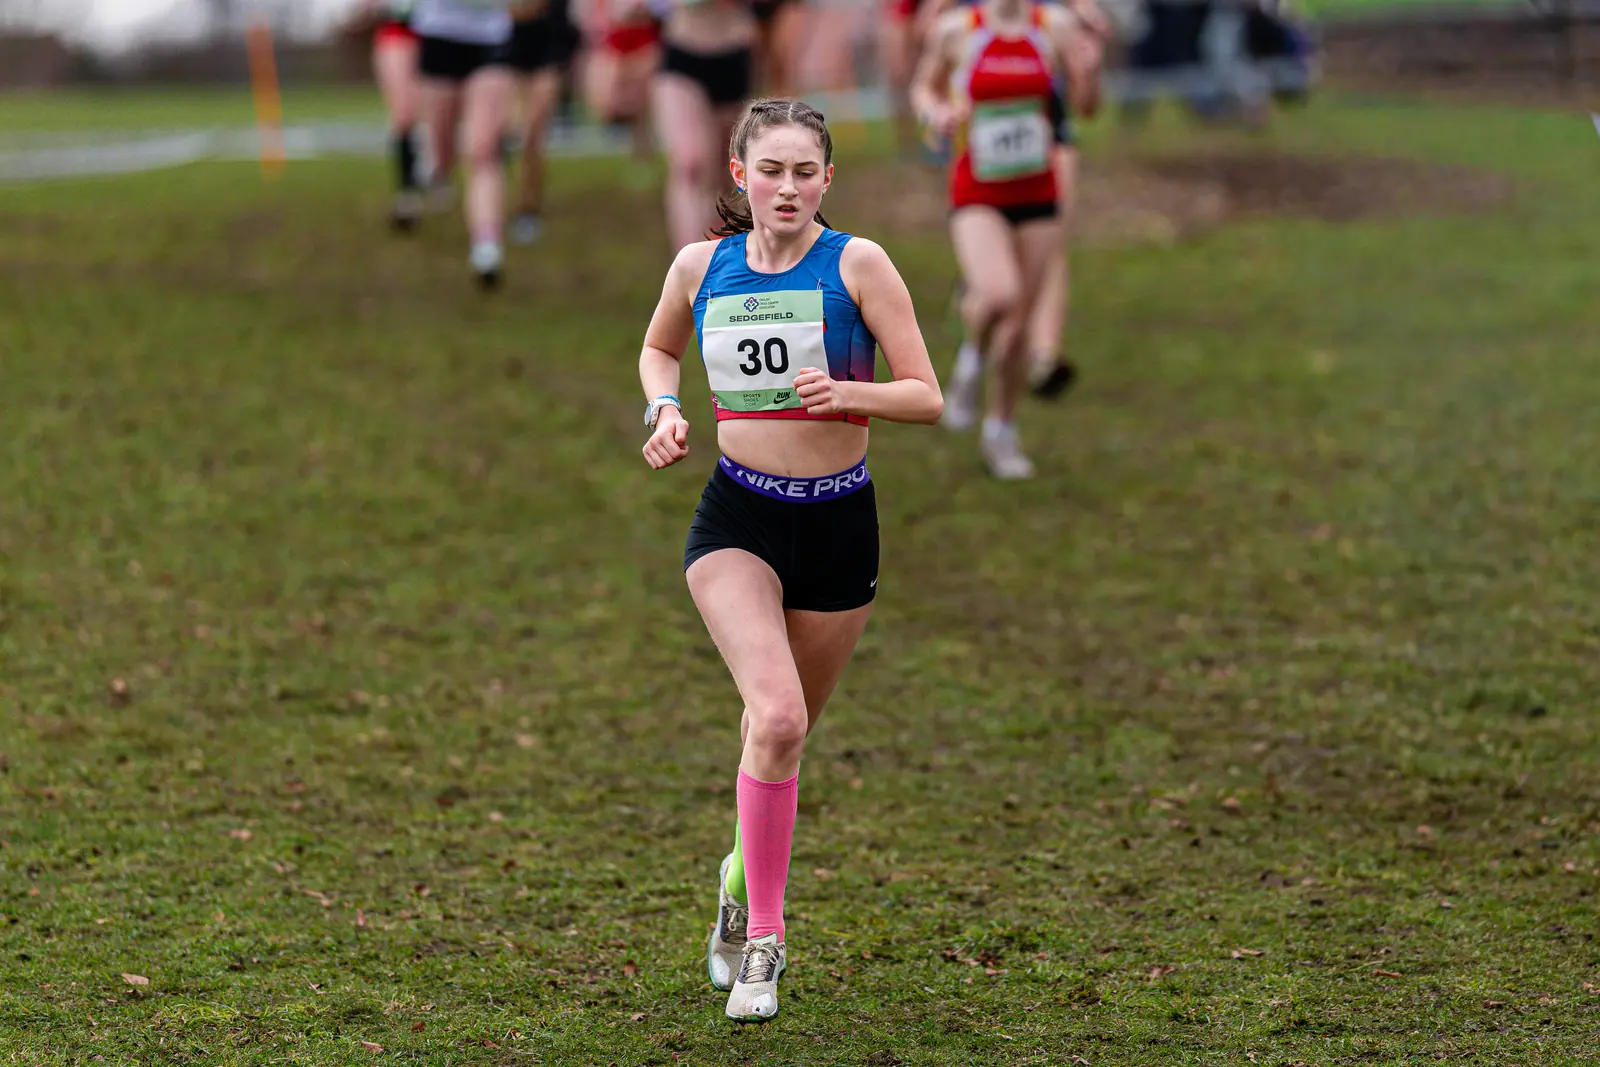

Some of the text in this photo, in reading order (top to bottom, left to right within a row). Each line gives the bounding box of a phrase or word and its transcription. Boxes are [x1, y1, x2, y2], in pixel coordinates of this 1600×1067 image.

[729, 312, 794, 323] SEDGEFIELD
[737, 337, 789, 376] 30
[736, 465, 866, 498] NIKE PRO
